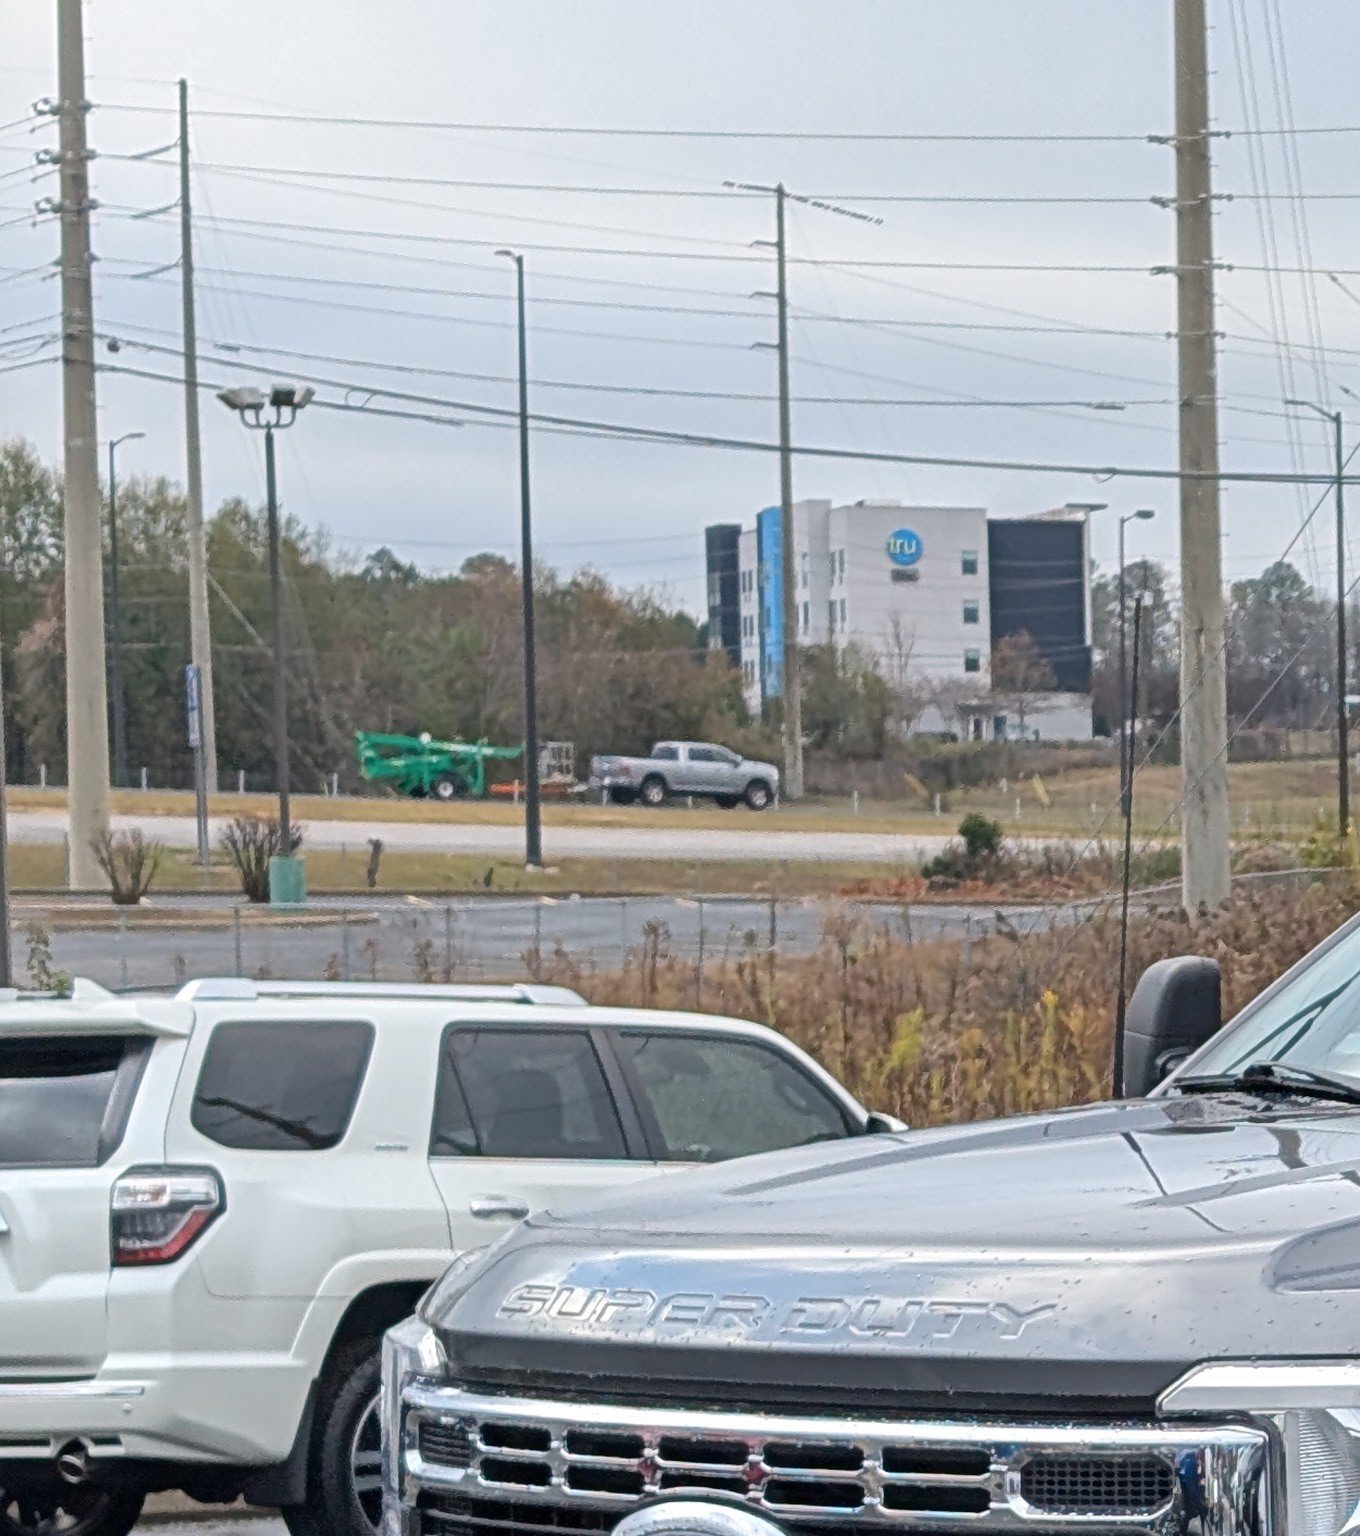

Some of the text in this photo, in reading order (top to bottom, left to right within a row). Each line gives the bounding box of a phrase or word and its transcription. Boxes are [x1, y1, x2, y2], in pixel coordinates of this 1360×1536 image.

[887, 538, 917, 555] tru
[497, 1283, 1058, 1340] SUPER DUTY
